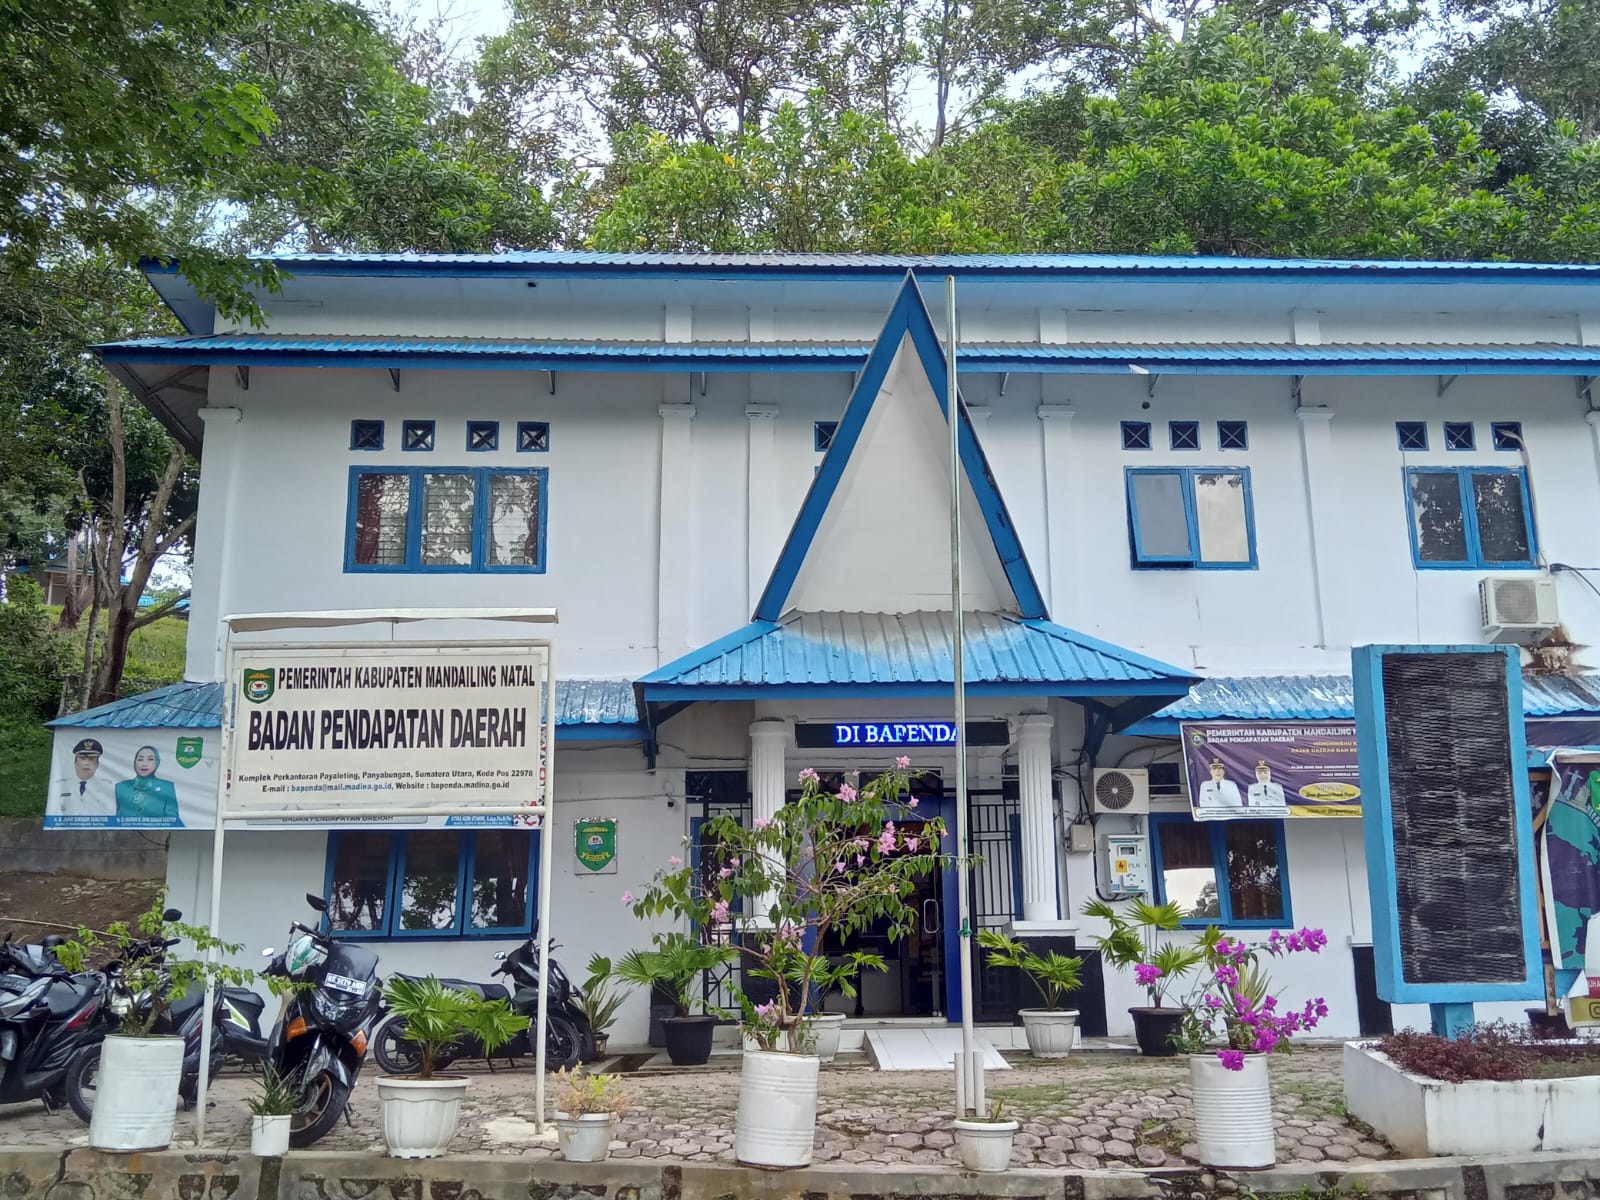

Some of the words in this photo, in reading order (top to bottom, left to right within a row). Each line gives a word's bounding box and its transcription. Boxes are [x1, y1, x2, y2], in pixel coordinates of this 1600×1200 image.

[278, 667, 351, 690] PEMERINTAH
[354, 666, 422, 688] KABUPATEN
[426, 665, 496, 688] MANDAILING
[500, 664, 536, 687] NATAL
[248, 710, 315, 750] BADAN
[320, 709, 444, 750] PENDAPATAN
[450, 708, 526, 748] DAERAH
[836, 725, 860, 743] DI
[452, 770, 475, 778] Utara,
[396, 782, 424, 790] Website
